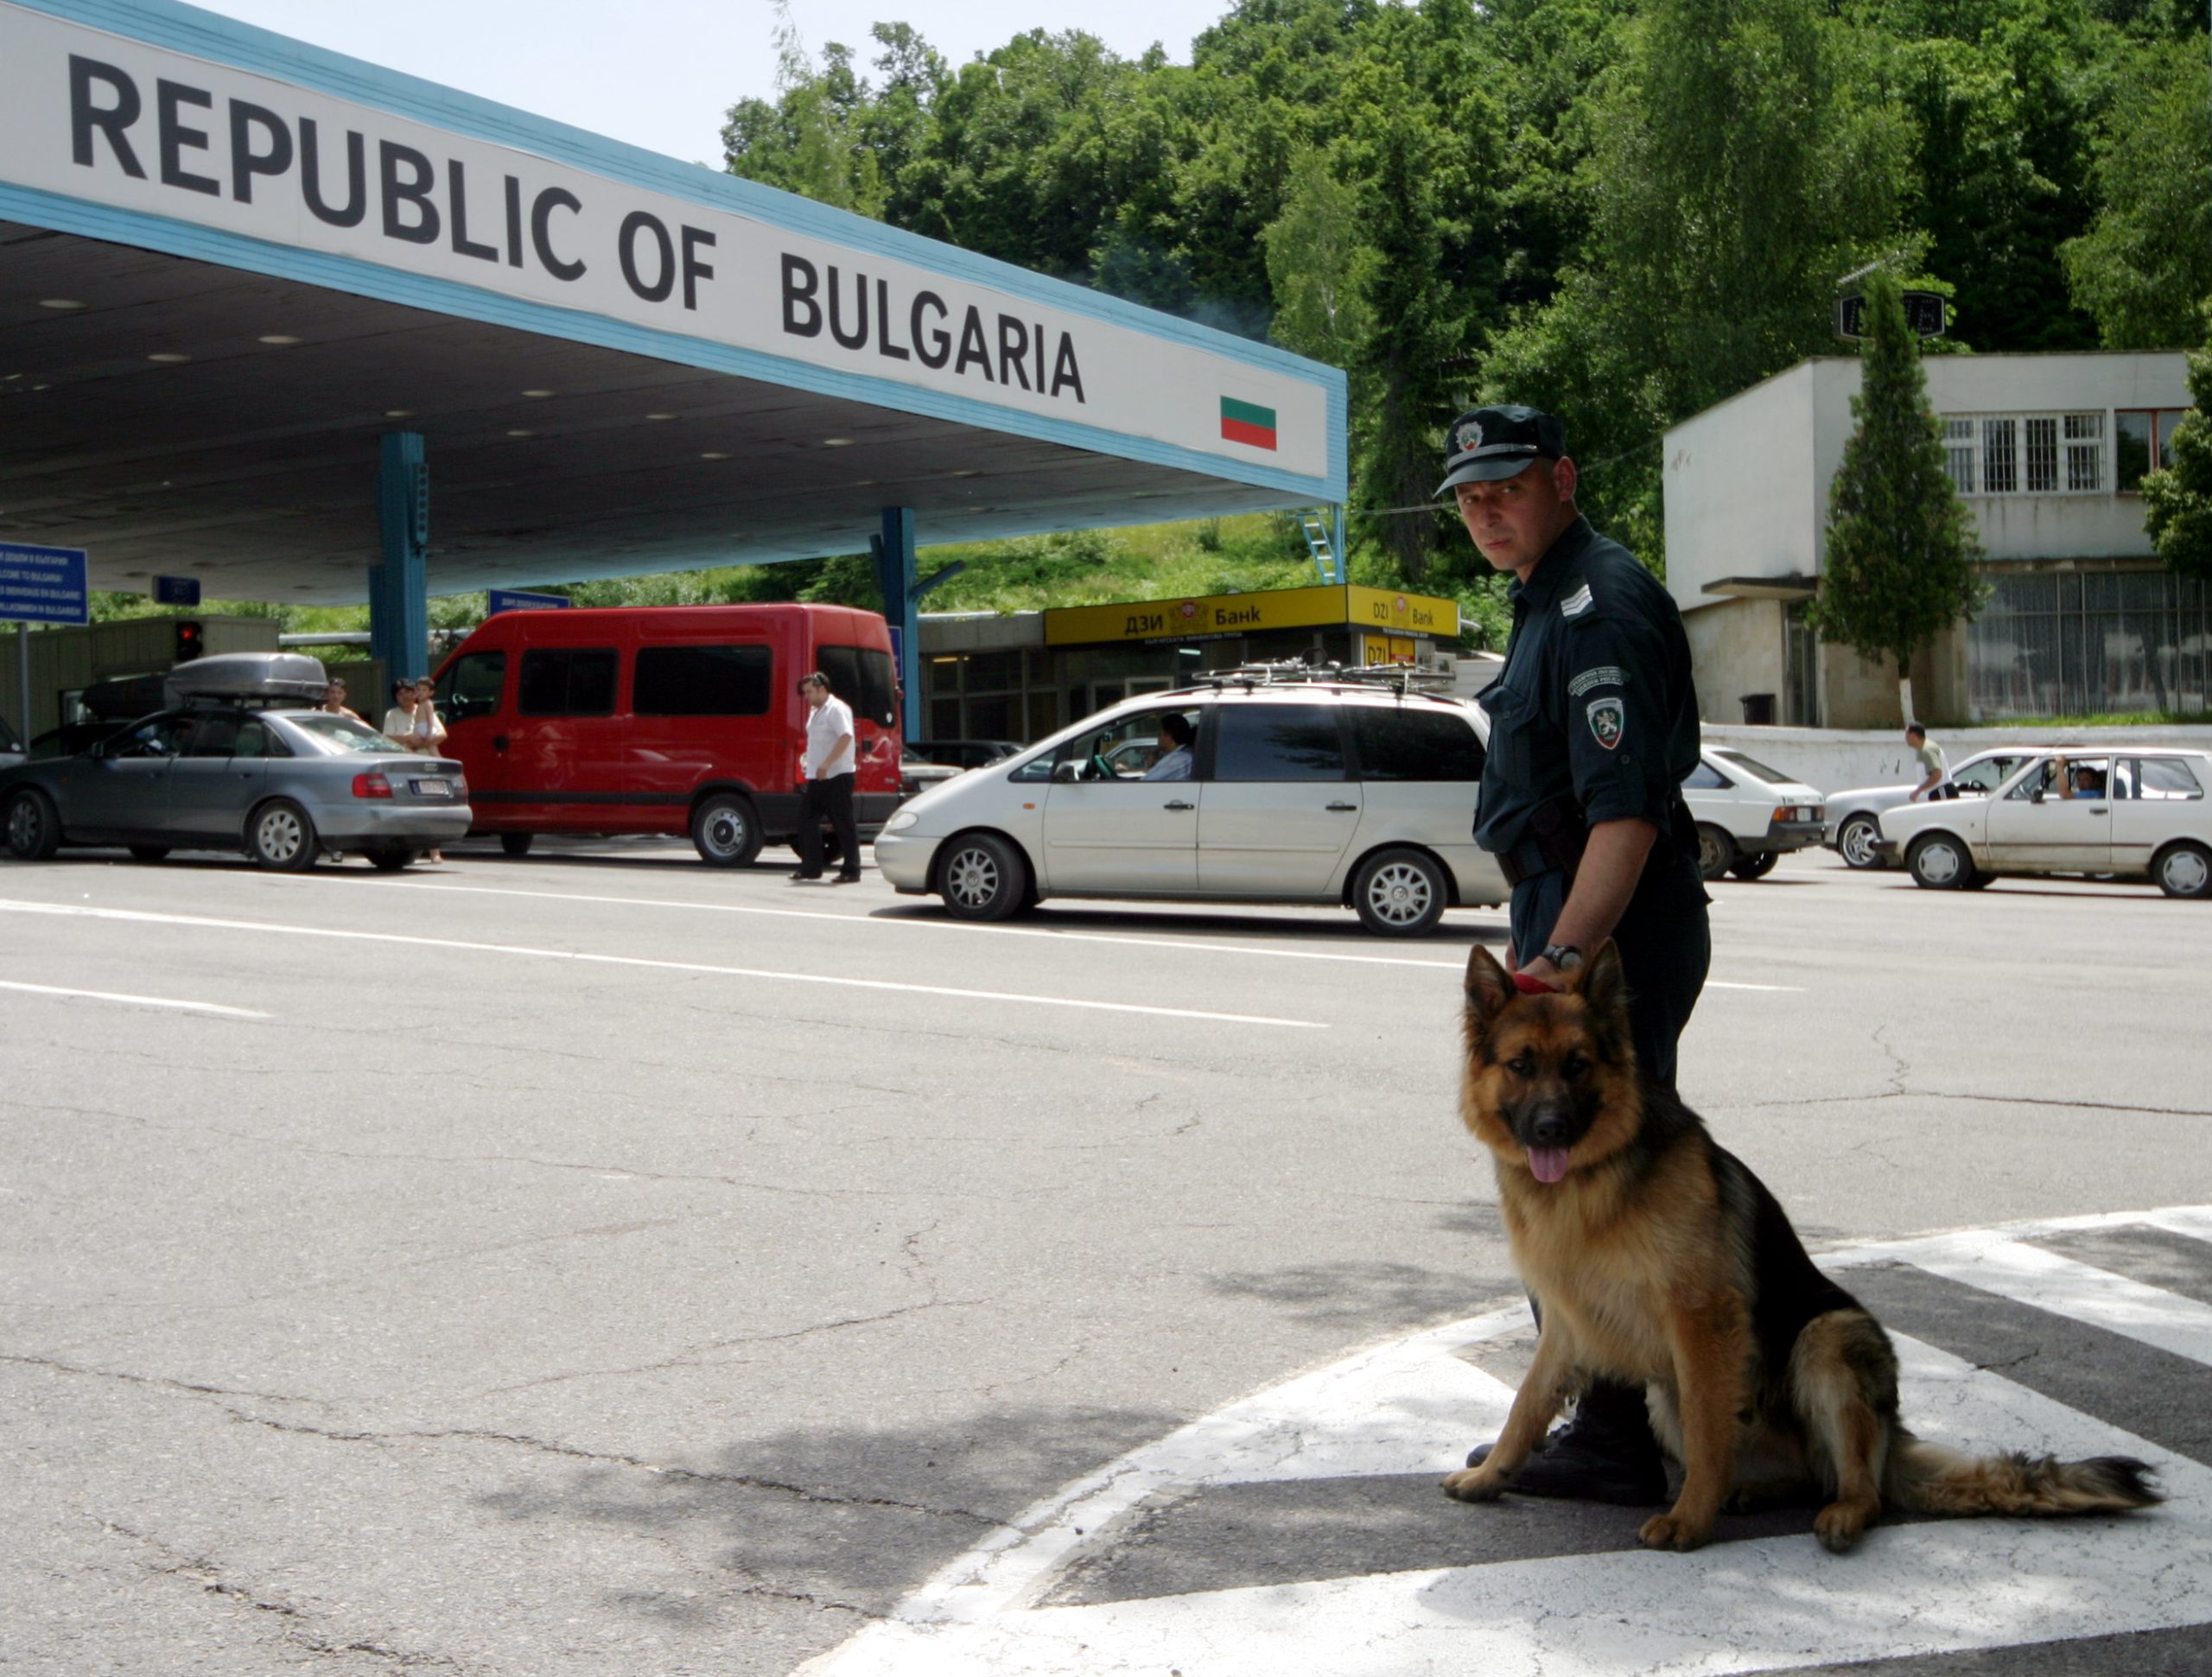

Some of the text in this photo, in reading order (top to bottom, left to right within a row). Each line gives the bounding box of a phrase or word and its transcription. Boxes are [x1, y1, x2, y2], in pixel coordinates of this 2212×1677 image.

[68, 54, 1086, 404] REPUBLIC OF BULGARIA
[1125, 606, 1261, 636] ДЗИ Банк
[1373, 601, 1433, 626] DZI Bank
[1368, 646, 1386, 664] DZI
